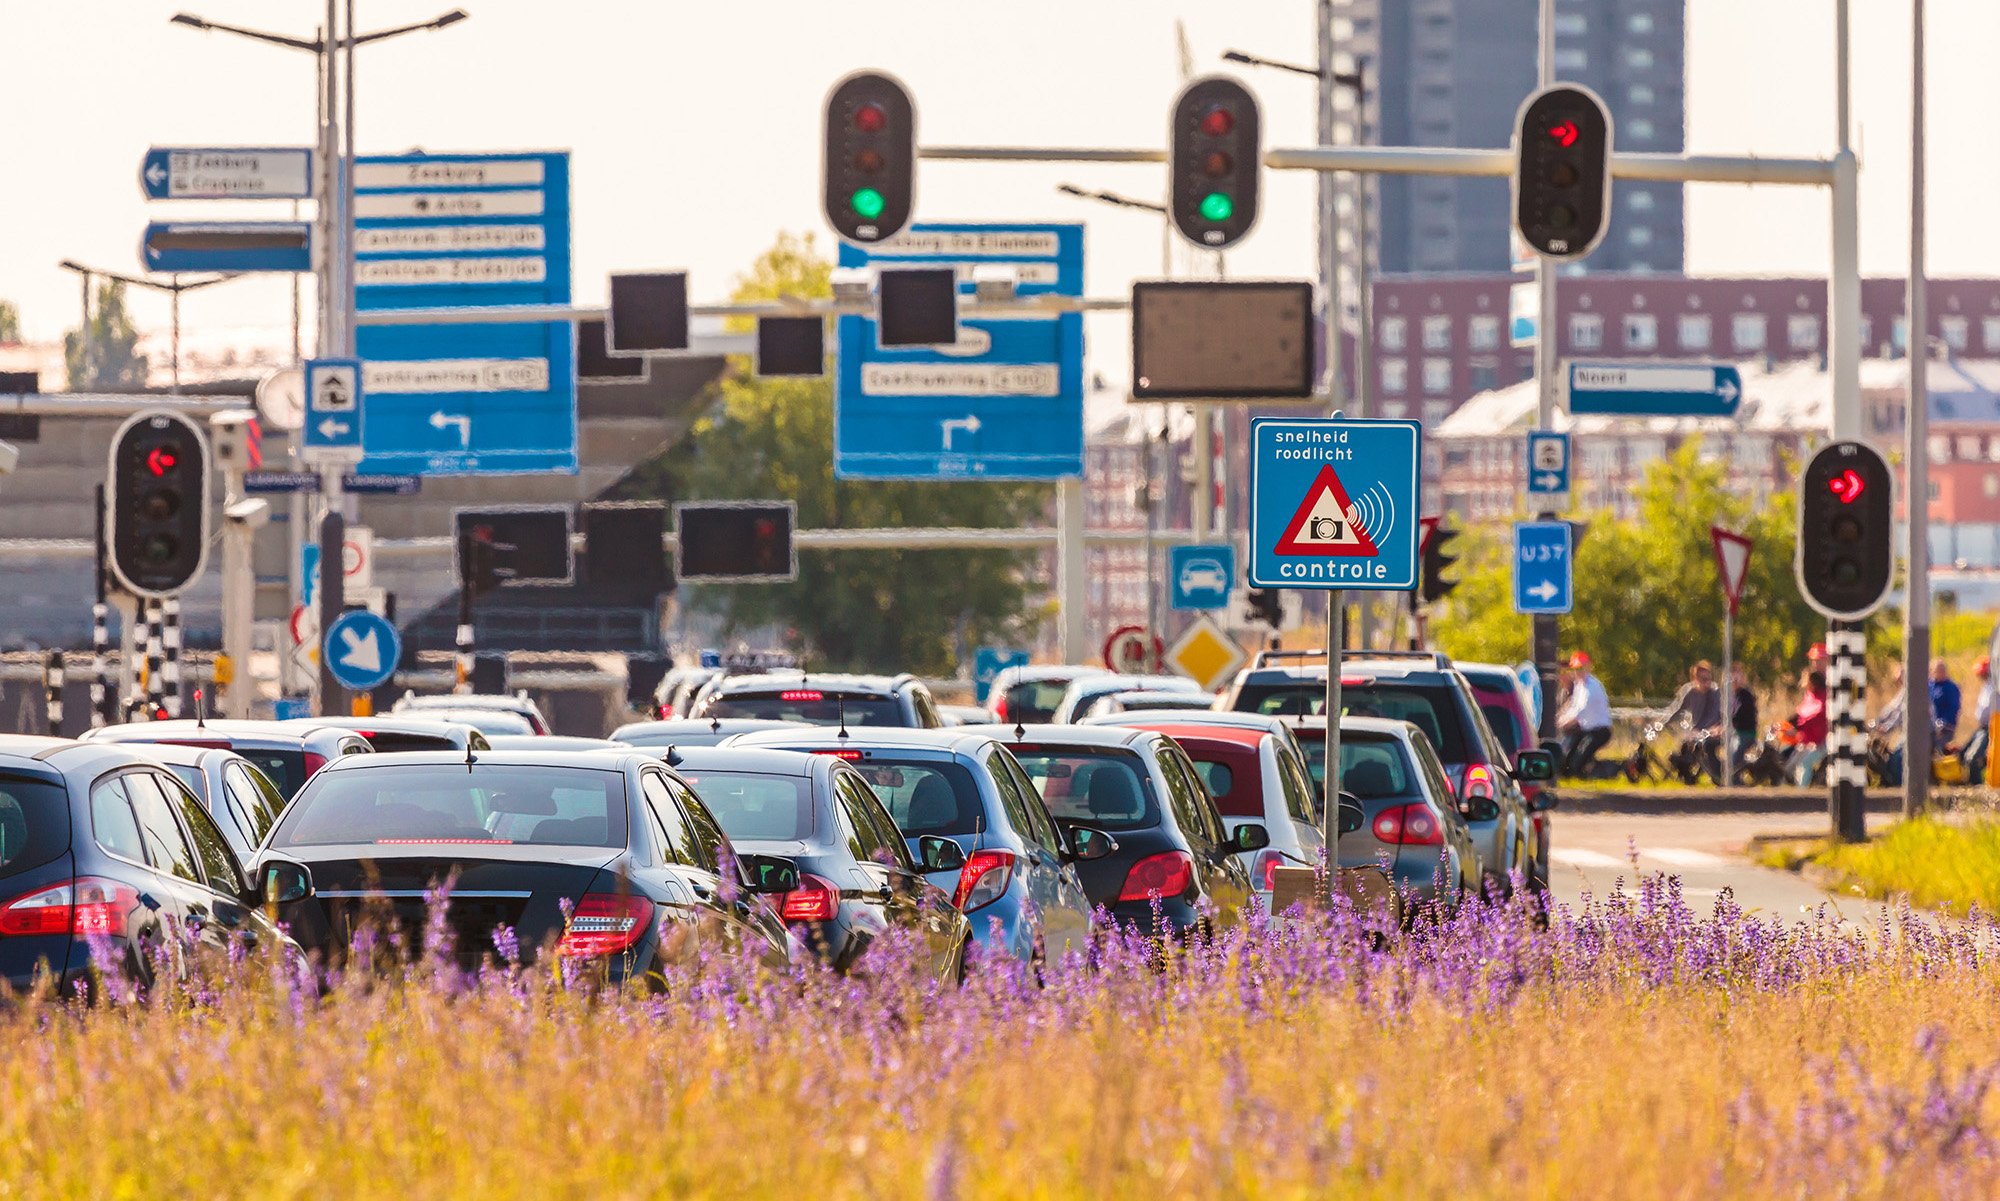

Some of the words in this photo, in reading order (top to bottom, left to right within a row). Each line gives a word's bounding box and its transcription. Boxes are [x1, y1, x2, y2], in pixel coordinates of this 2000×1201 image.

[408, 164, 486, 184] Zeeburg
[1577, 370, 1627, 384] Noord
[1275, 430, 1348, 443] snelheid
[1275, 447, 1353, 461] roodlicht
[1520, 543, 1564, 562] U37
[1280, 560, 1387, 579] controle
